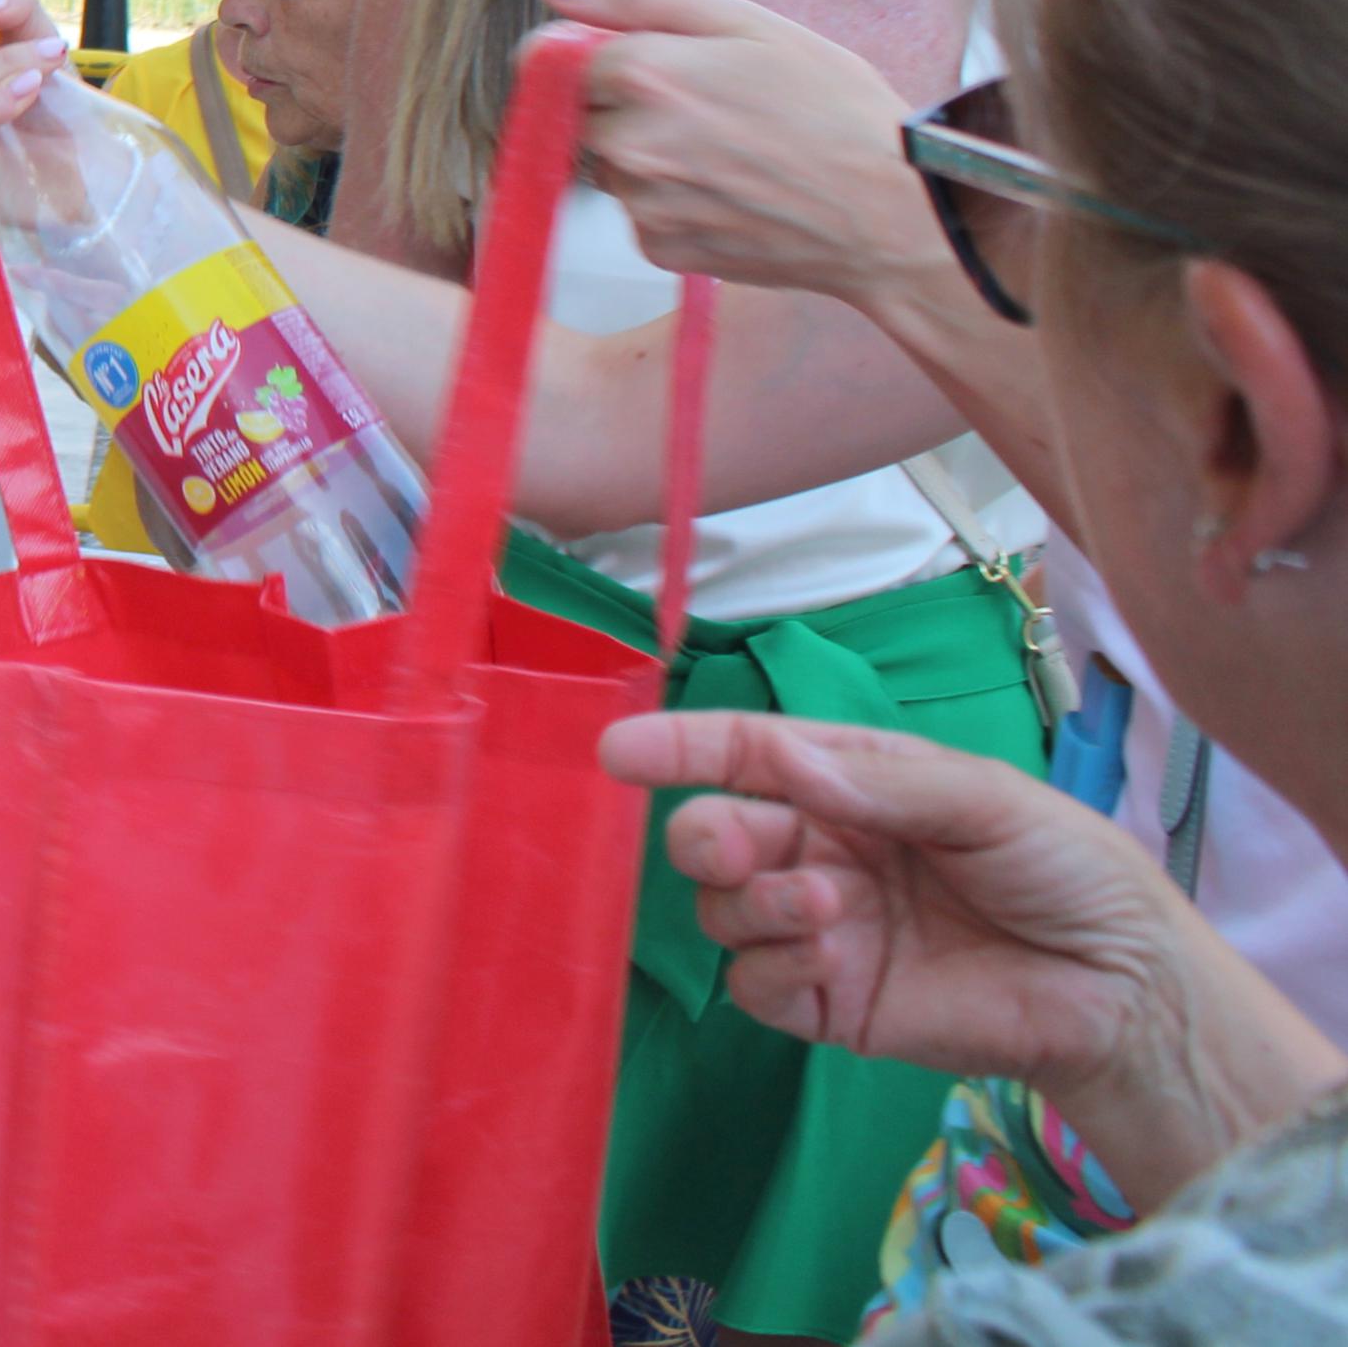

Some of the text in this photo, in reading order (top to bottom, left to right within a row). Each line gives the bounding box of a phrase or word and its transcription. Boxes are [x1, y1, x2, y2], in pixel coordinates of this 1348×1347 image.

[144, 316, 241, 458] Casera
[190, 429, 228, 465] TINTO
[203, 438, 251, 483] VERANO
